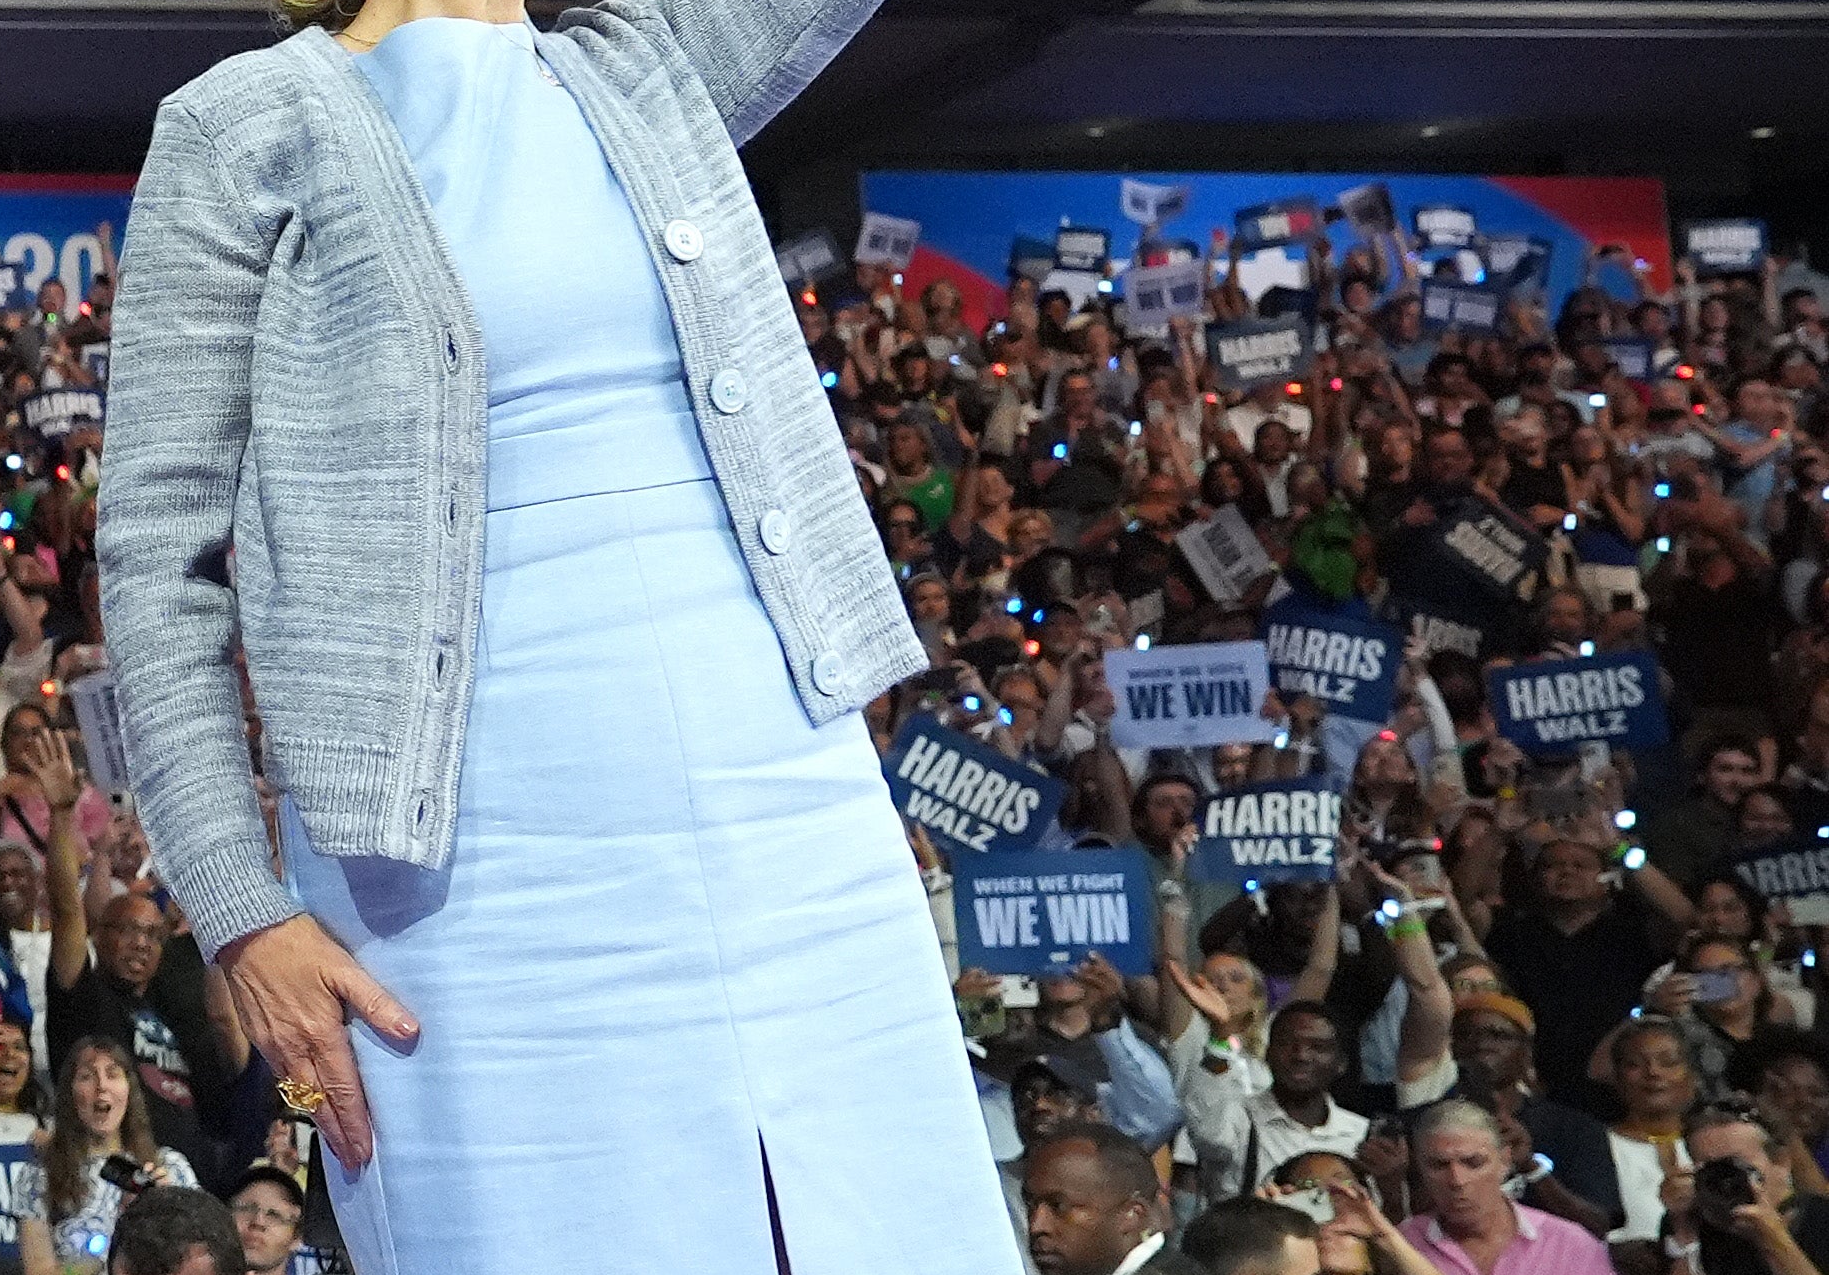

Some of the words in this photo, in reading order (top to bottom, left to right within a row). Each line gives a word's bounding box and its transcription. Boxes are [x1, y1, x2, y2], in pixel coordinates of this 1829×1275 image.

[1268, 623, 1386, 682] HARRIS
[1126, 682, 1175, 721] WE
[1181, 677, 1252, 718] WIN
[1506, 665, 1645, 722] HARRIS
[1535, 709, 1629, 744] WALZ
[897, 733, 1041, 836] HARRIS
[905, 788, 997, 854] WALZ
[1230, 837, 1334, 867] WALZ
[973, 894, 1041, 949] WE
[1045, 892, 1131, 946] WIN
